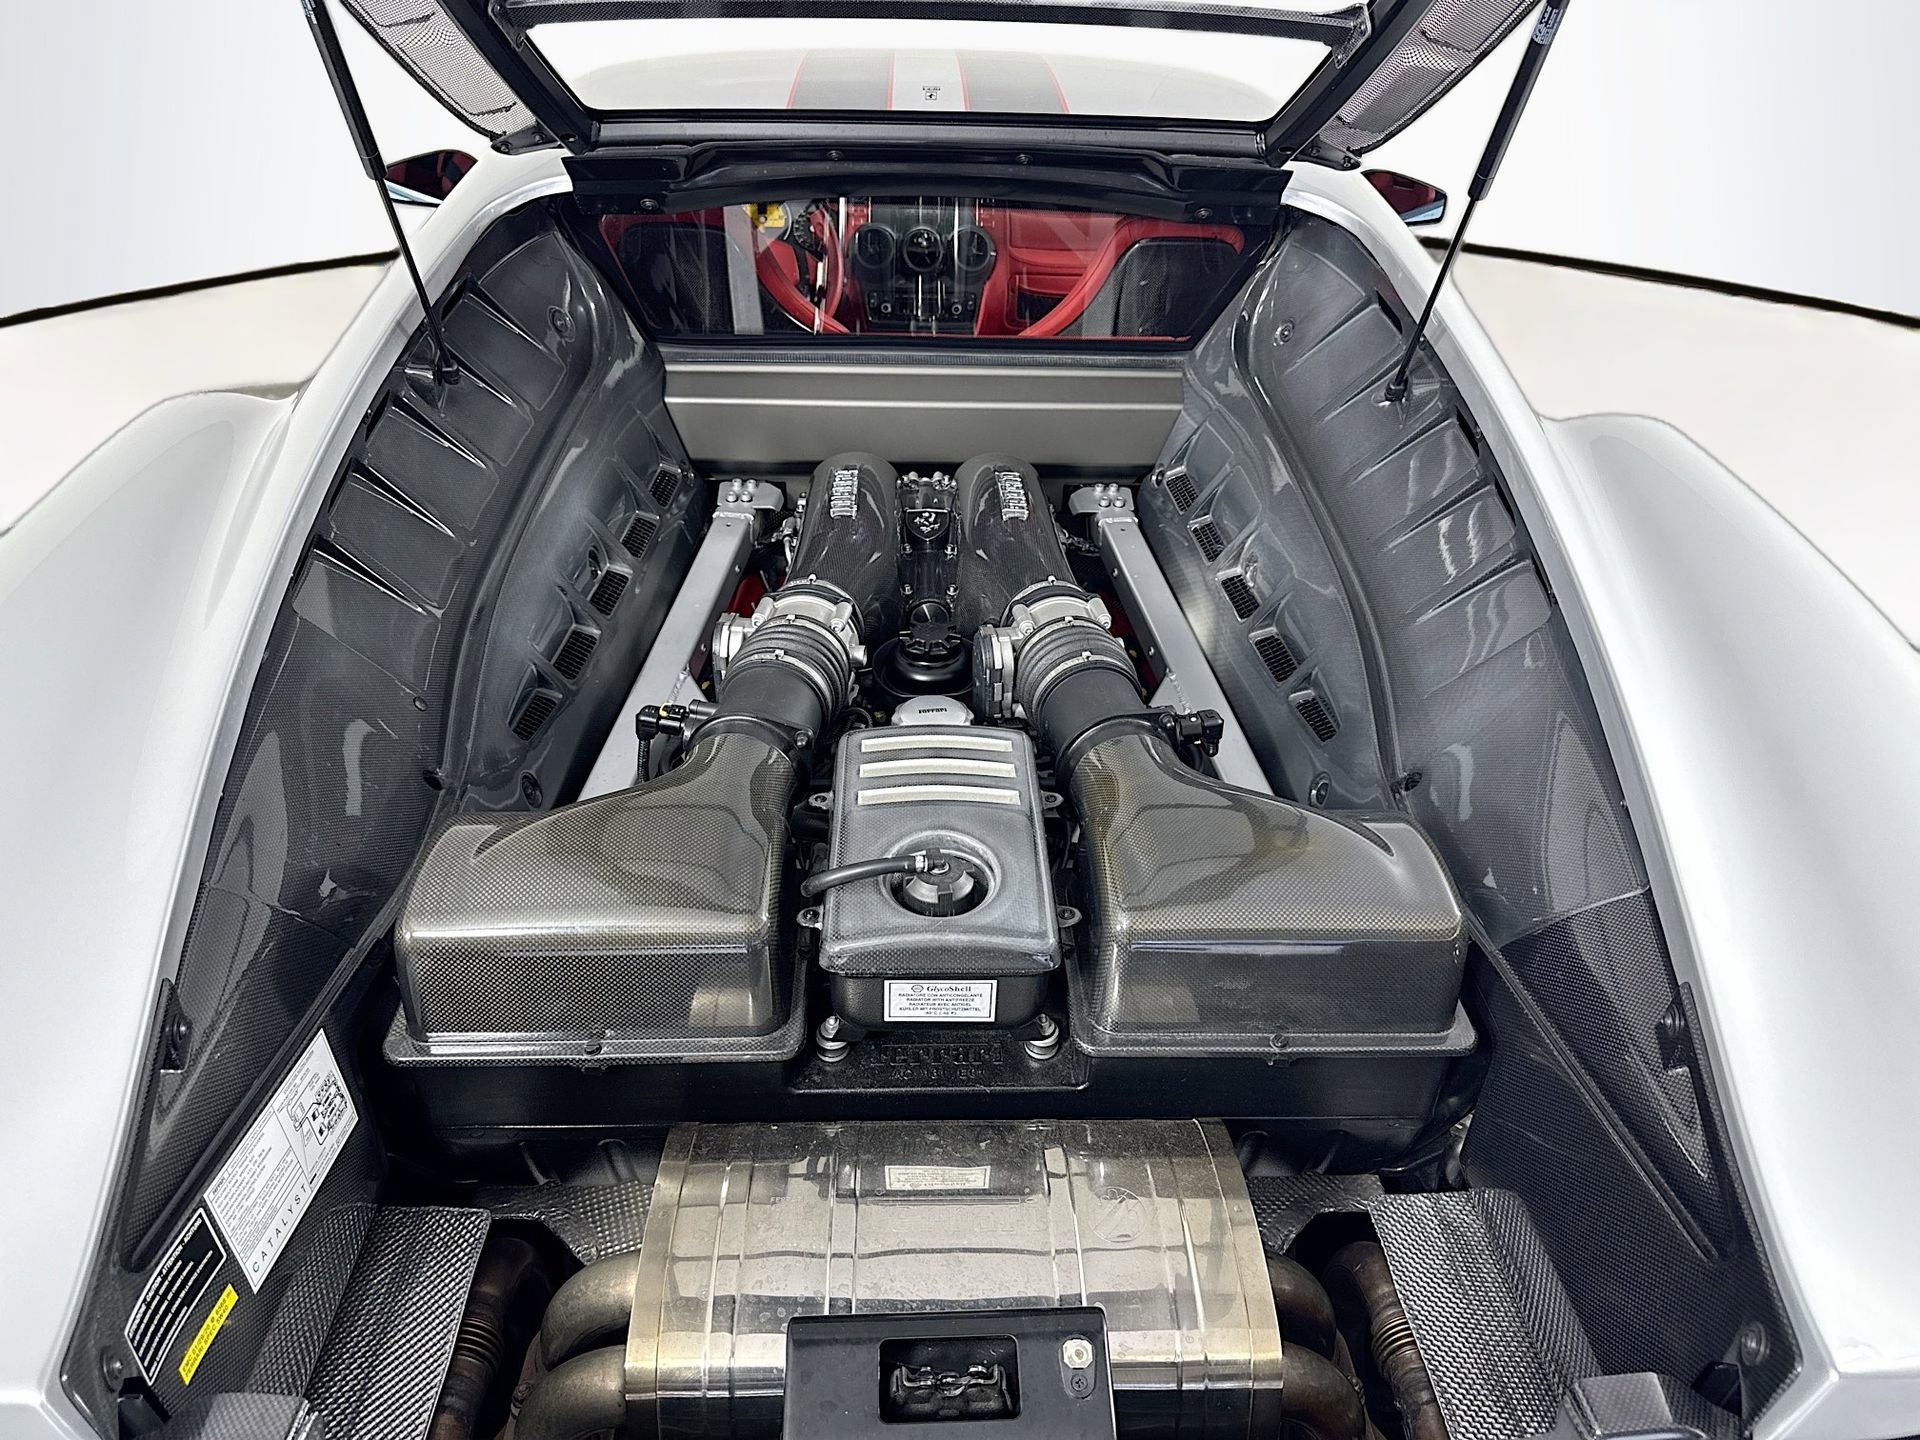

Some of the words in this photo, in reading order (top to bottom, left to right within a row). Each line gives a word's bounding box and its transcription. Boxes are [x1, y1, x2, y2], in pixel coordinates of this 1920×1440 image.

[926, 985, 972, 993] GlycoShell
[145, 1274, 161, 1302] CAUTION
[161, 1242, 183, 1275] ATTENTION
[182, 1216, 202, 1244] ACHTUNG
[252, 1183, 307, 1273] CATALYST
[184, 1344, 204, 1378] FERRARI
[203, 1323, 216, 1345] SPEC
